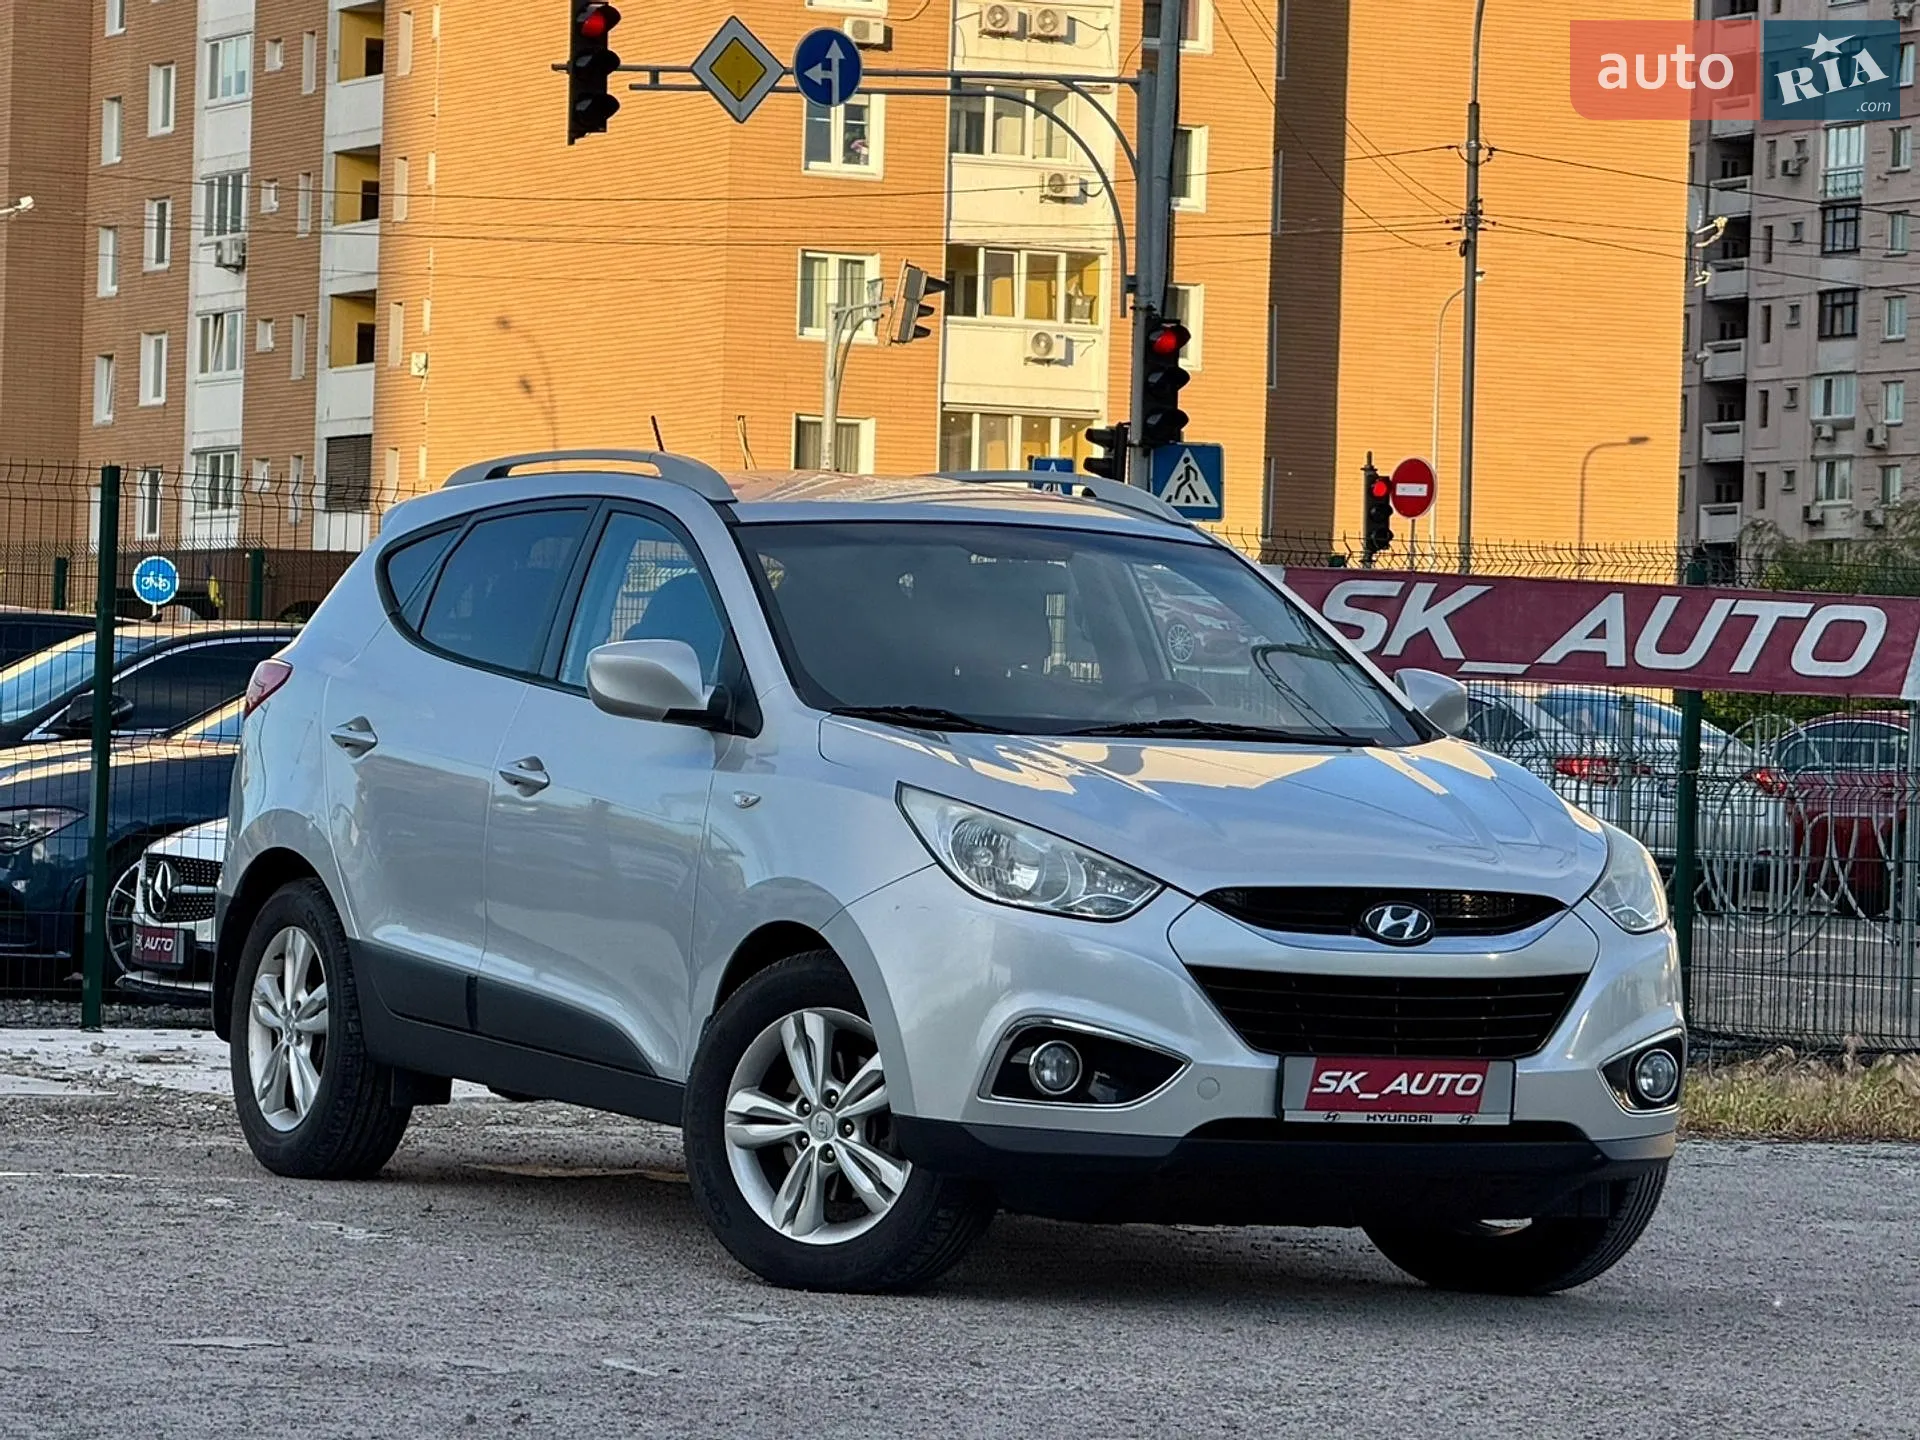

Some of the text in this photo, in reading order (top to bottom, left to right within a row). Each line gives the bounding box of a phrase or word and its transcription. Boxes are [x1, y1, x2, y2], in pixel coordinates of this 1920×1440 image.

[1322, 579, 1888, 677] SK_AUTO
[1312, 1071, 1484, 1099] SK_AUTO
[1366, 1114, 1433, 1124] HYUNDAI
